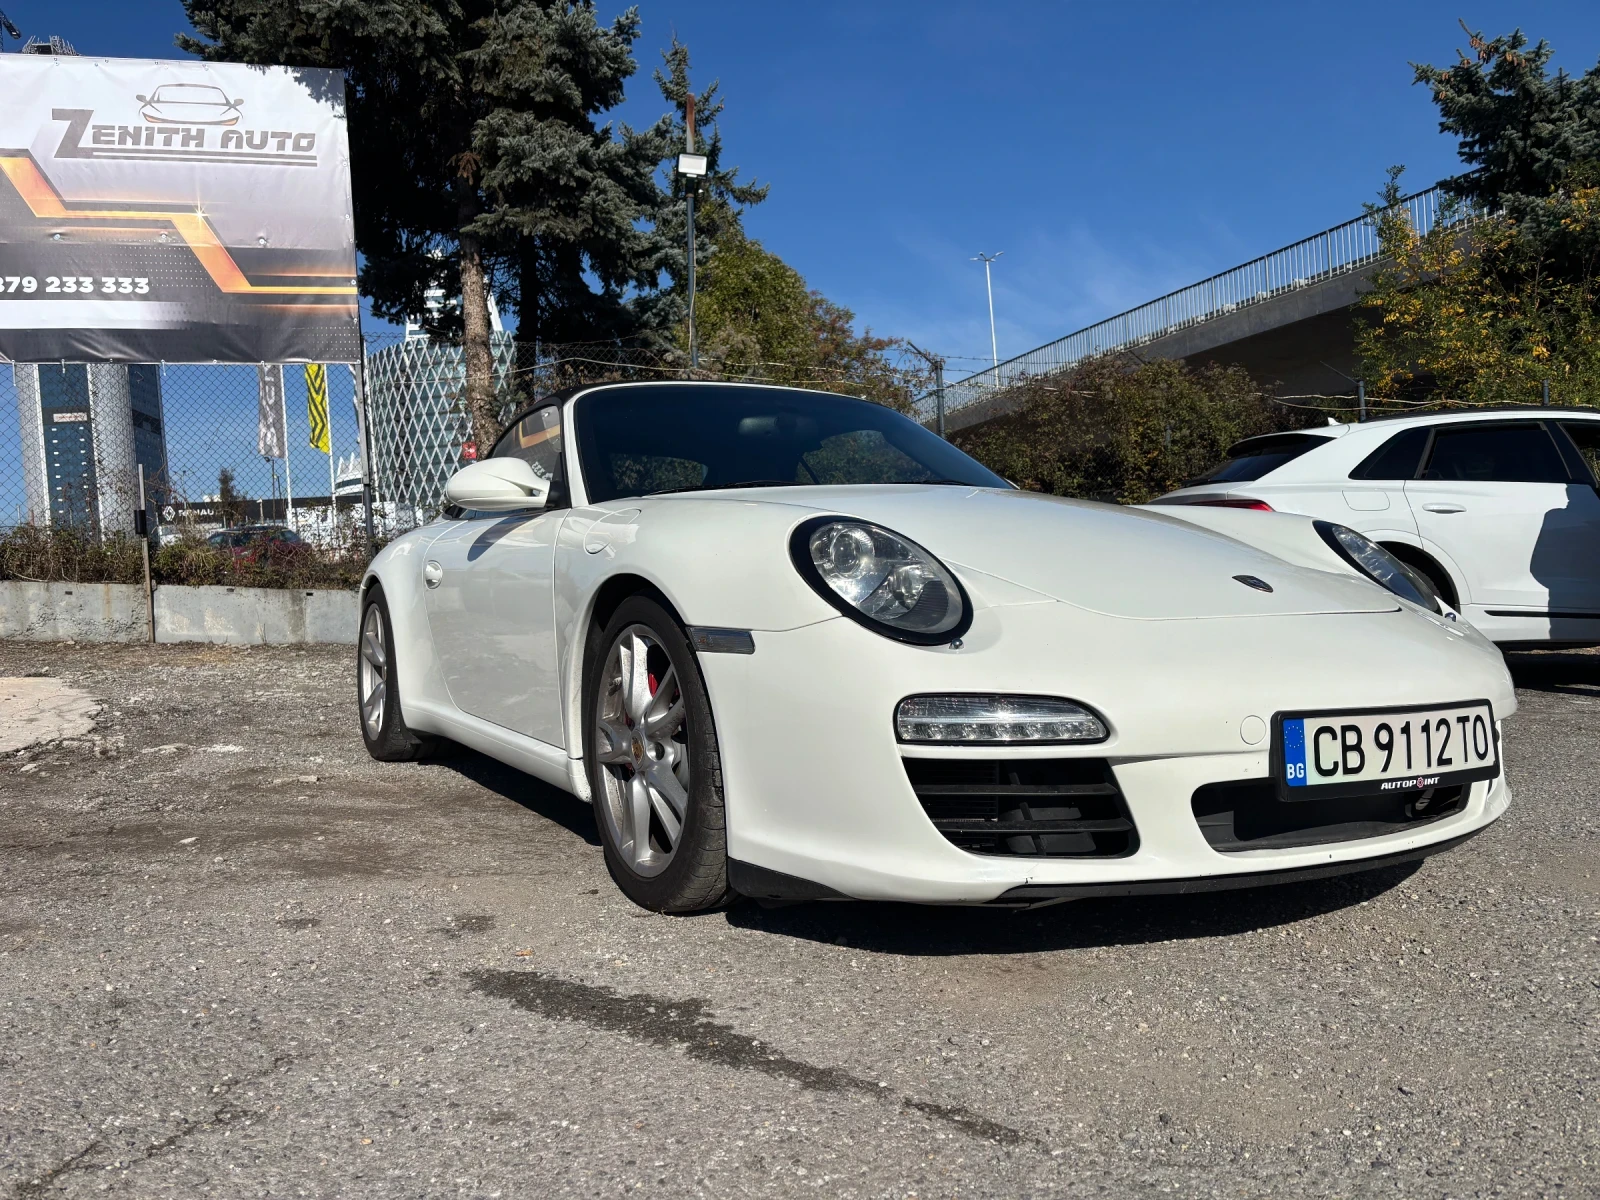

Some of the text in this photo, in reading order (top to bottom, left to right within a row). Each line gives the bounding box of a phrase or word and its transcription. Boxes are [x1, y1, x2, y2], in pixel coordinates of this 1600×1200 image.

[51, 108, 316, 159] ZENITH AUTO
[45, 276, 94, 293] 233
[101, 276, 150, 294] 333
[1313, 714, 1489, 777] CB 9112 TO
[1286, 763, 1305, 780] BG
[1380, 776, 1440, 790] AUTOPOINT
